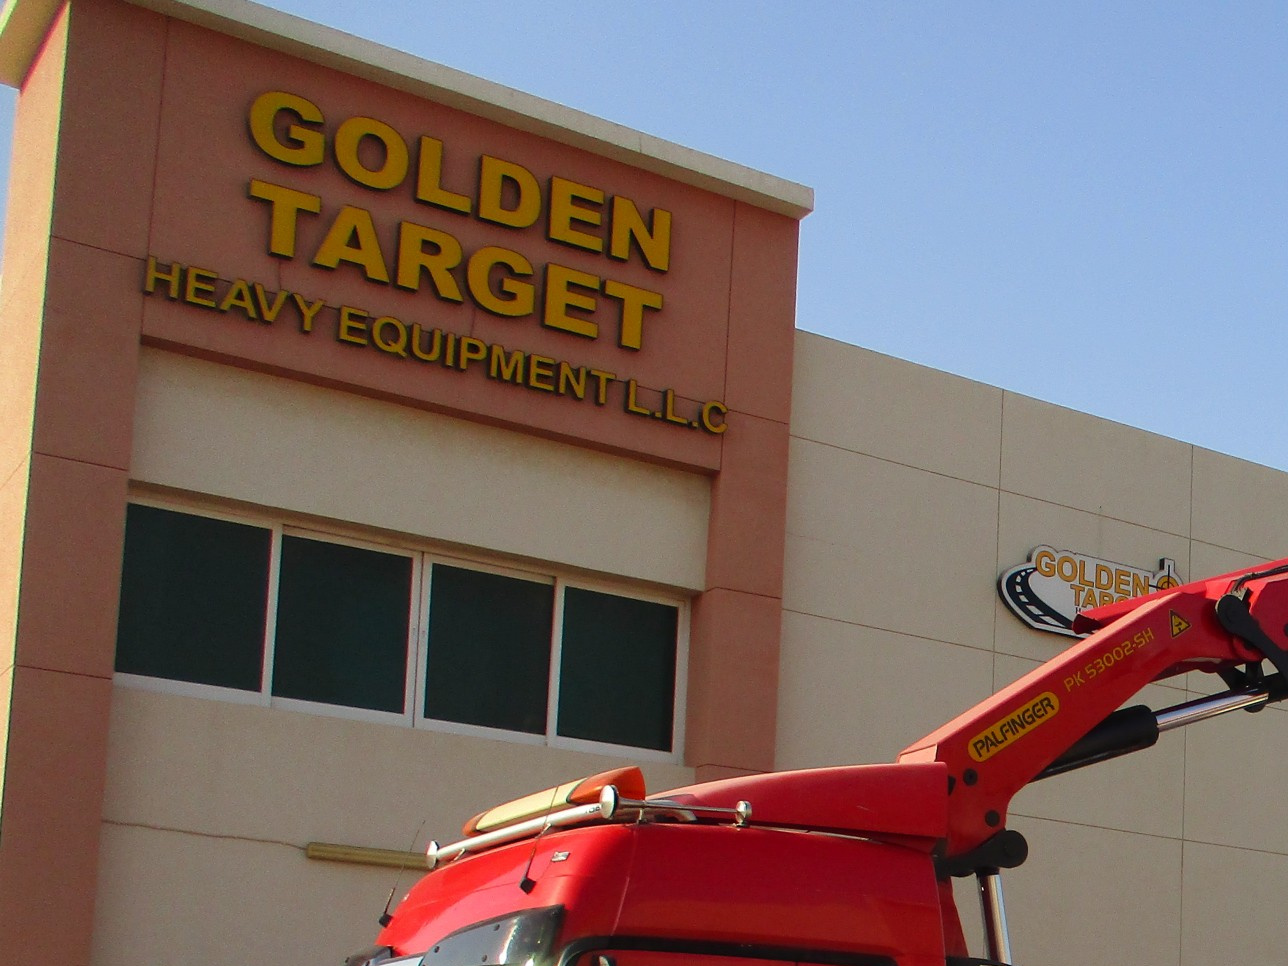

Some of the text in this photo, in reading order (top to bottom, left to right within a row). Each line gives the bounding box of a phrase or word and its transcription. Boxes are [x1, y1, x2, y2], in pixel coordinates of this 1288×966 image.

[249, 91, 673, 272] GOLDEN
[248, 179, 663, 351] TARGET
[144, 256, 730, 436] HEAVY EQUIPMENT L.L.C
[1035, 550, 1150, 597] GOLDEN
[1063, 627, 1155, 692] PK 53002-SH
[972, 695, 1056, 758] PALFINGER
